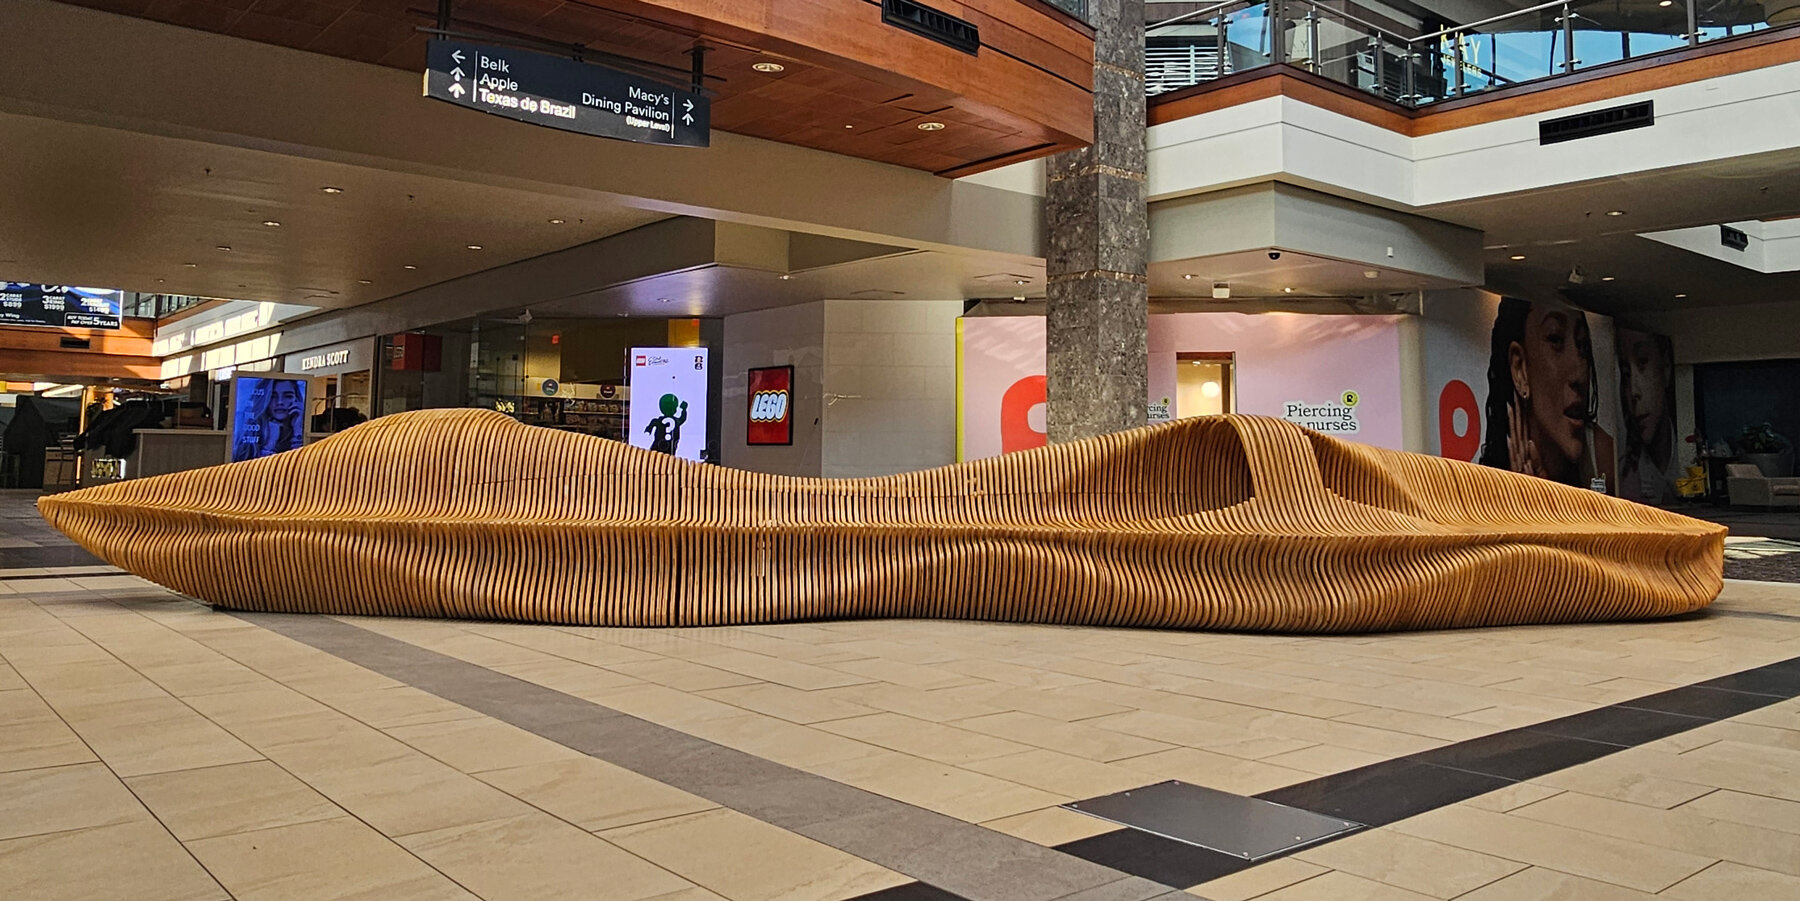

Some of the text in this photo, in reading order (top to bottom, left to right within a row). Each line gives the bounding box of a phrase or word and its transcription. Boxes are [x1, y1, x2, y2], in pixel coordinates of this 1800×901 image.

[481, 56, 509, 73] Belk
[479, 73, 518, 91] Apple
[479, 88, 576, 119] Texas de Brazil
[629, 86, 670, 106] Macy's
[582, 92, 669, 121] Dining Pavilion
[42, 295, 49, 304] 3
[93, 316, 100, 326] 5
[302, 350, 350, 371] KENDRA SCOTT
[751, 391, 788, 422] LEGO
[1147, 403, 1168, 414] cing
[1286, 403, 1353, 420] Piercing
[1307, 421, 1357, 431] nurses
